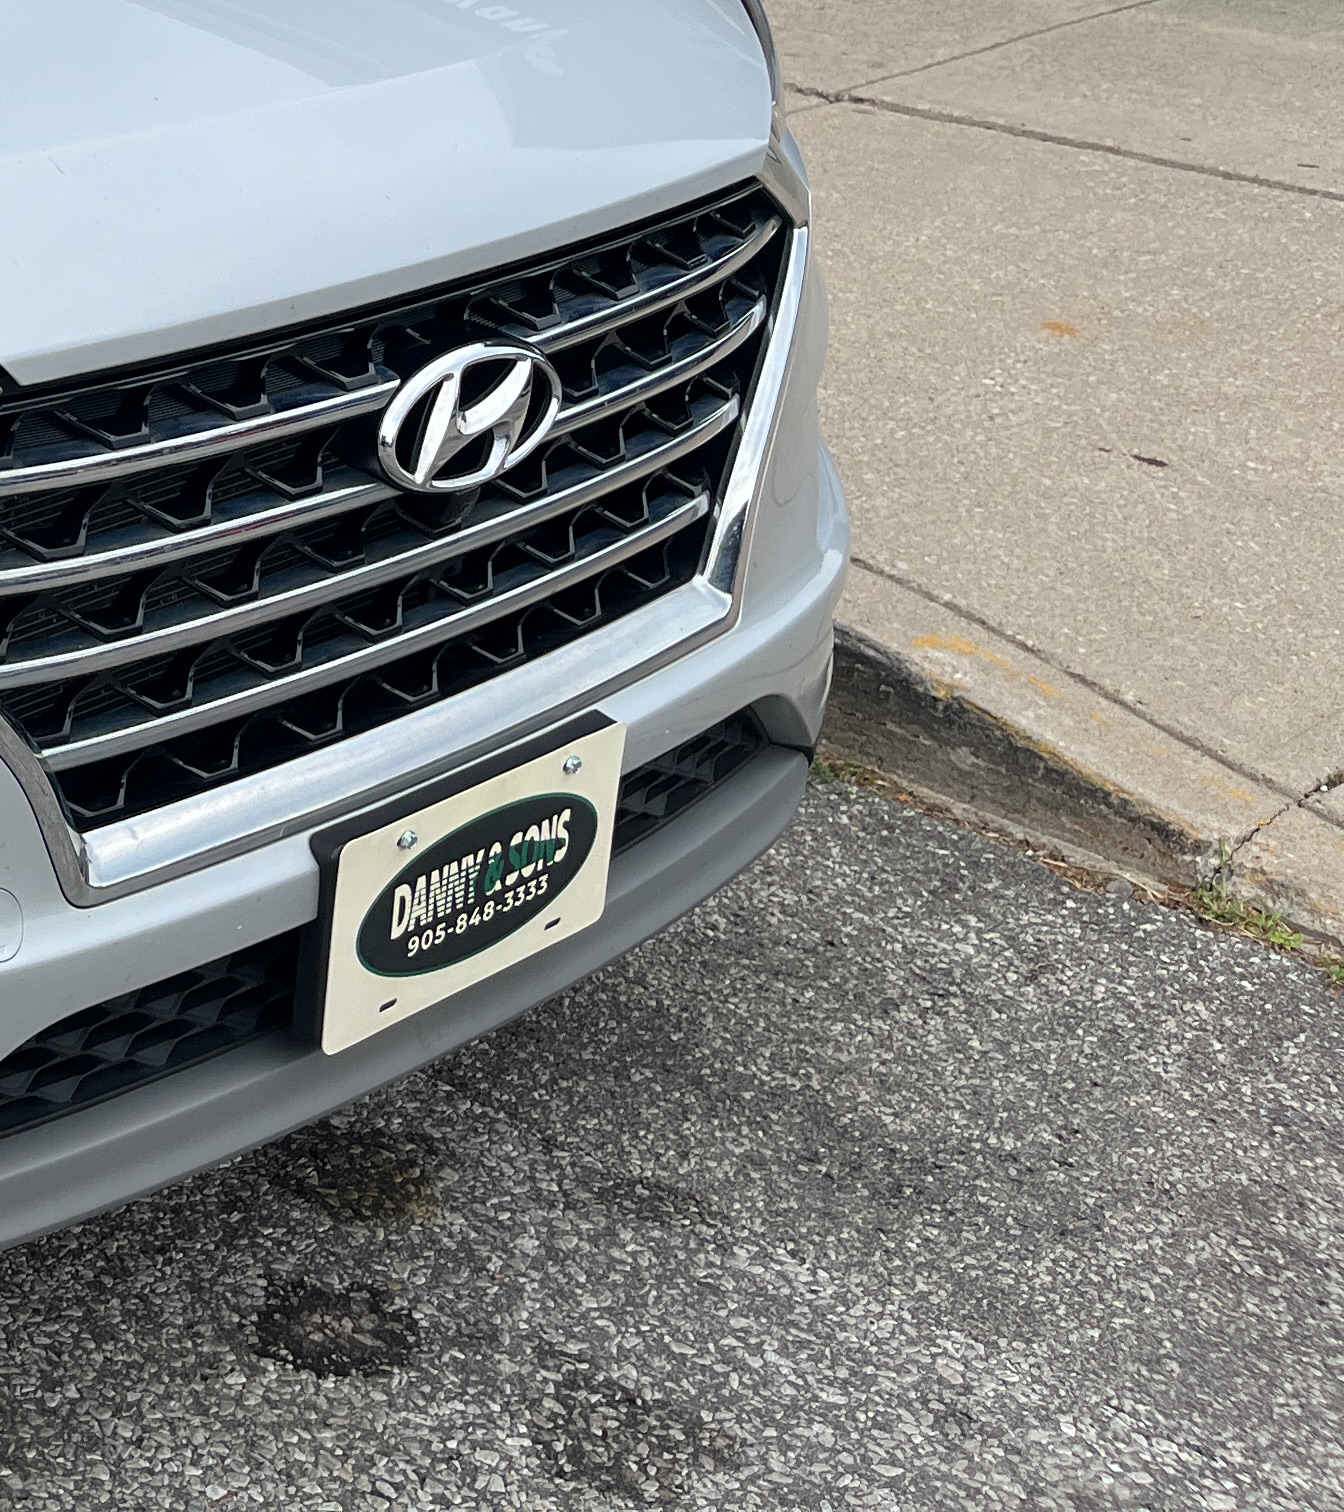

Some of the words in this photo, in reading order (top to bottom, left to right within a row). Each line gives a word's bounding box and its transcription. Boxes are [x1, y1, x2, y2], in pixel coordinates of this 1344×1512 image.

[390, 847, 486, 940] DANNY
[484, 840, 504, 896] &
[505, 808, 572, 886] SONS
[407, 873, 550, 958] 905-848-3333
